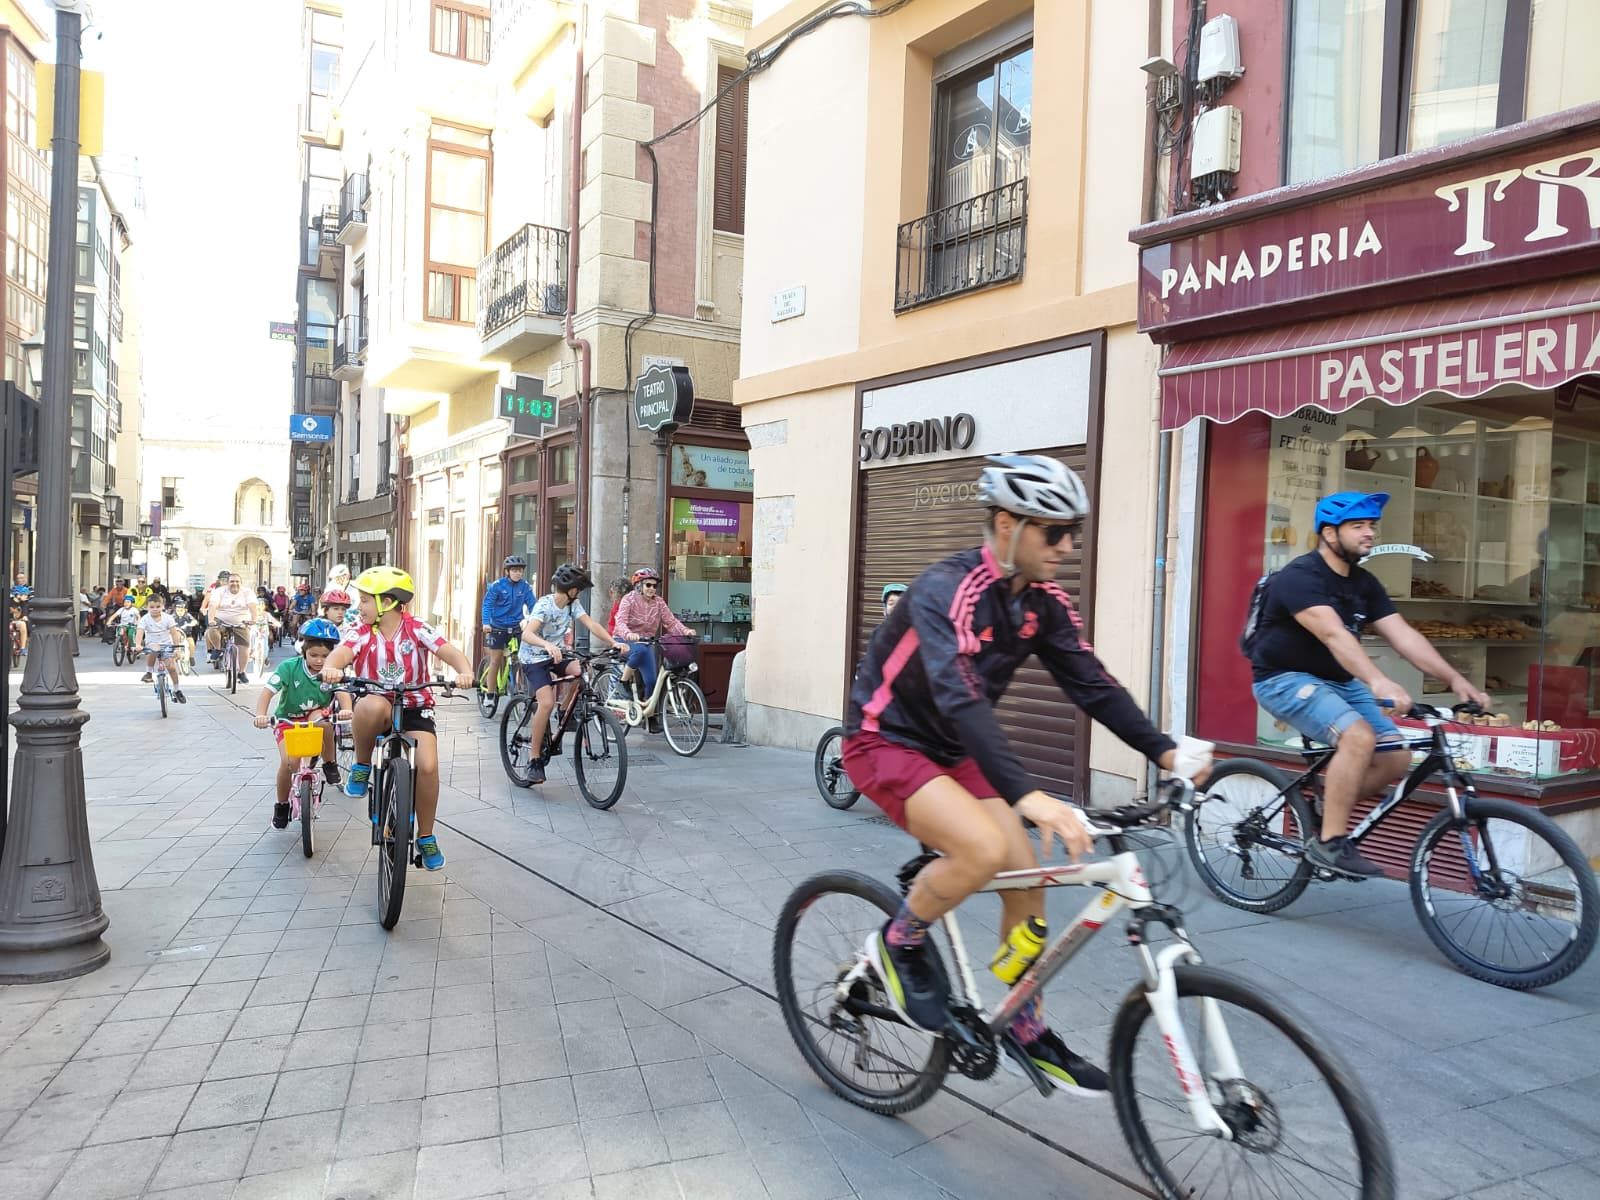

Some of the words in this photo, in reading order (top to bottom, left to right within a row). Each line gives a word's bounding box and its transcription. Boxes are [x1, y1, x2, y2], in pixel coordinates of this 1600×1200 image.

[1161, 220, 1383, 299] PANADERIA
[642, 380, 665, 396] TEATRO
[504, 393, 553, 419] 11:03
[639, 399, 670, 417] PRINCIPAL
[859, 412, 976, 462] SOBRINO
[700, 453, 712, 462] Un
[717, 465, 727, 473] de
[728, 466, 745, 474] toda
